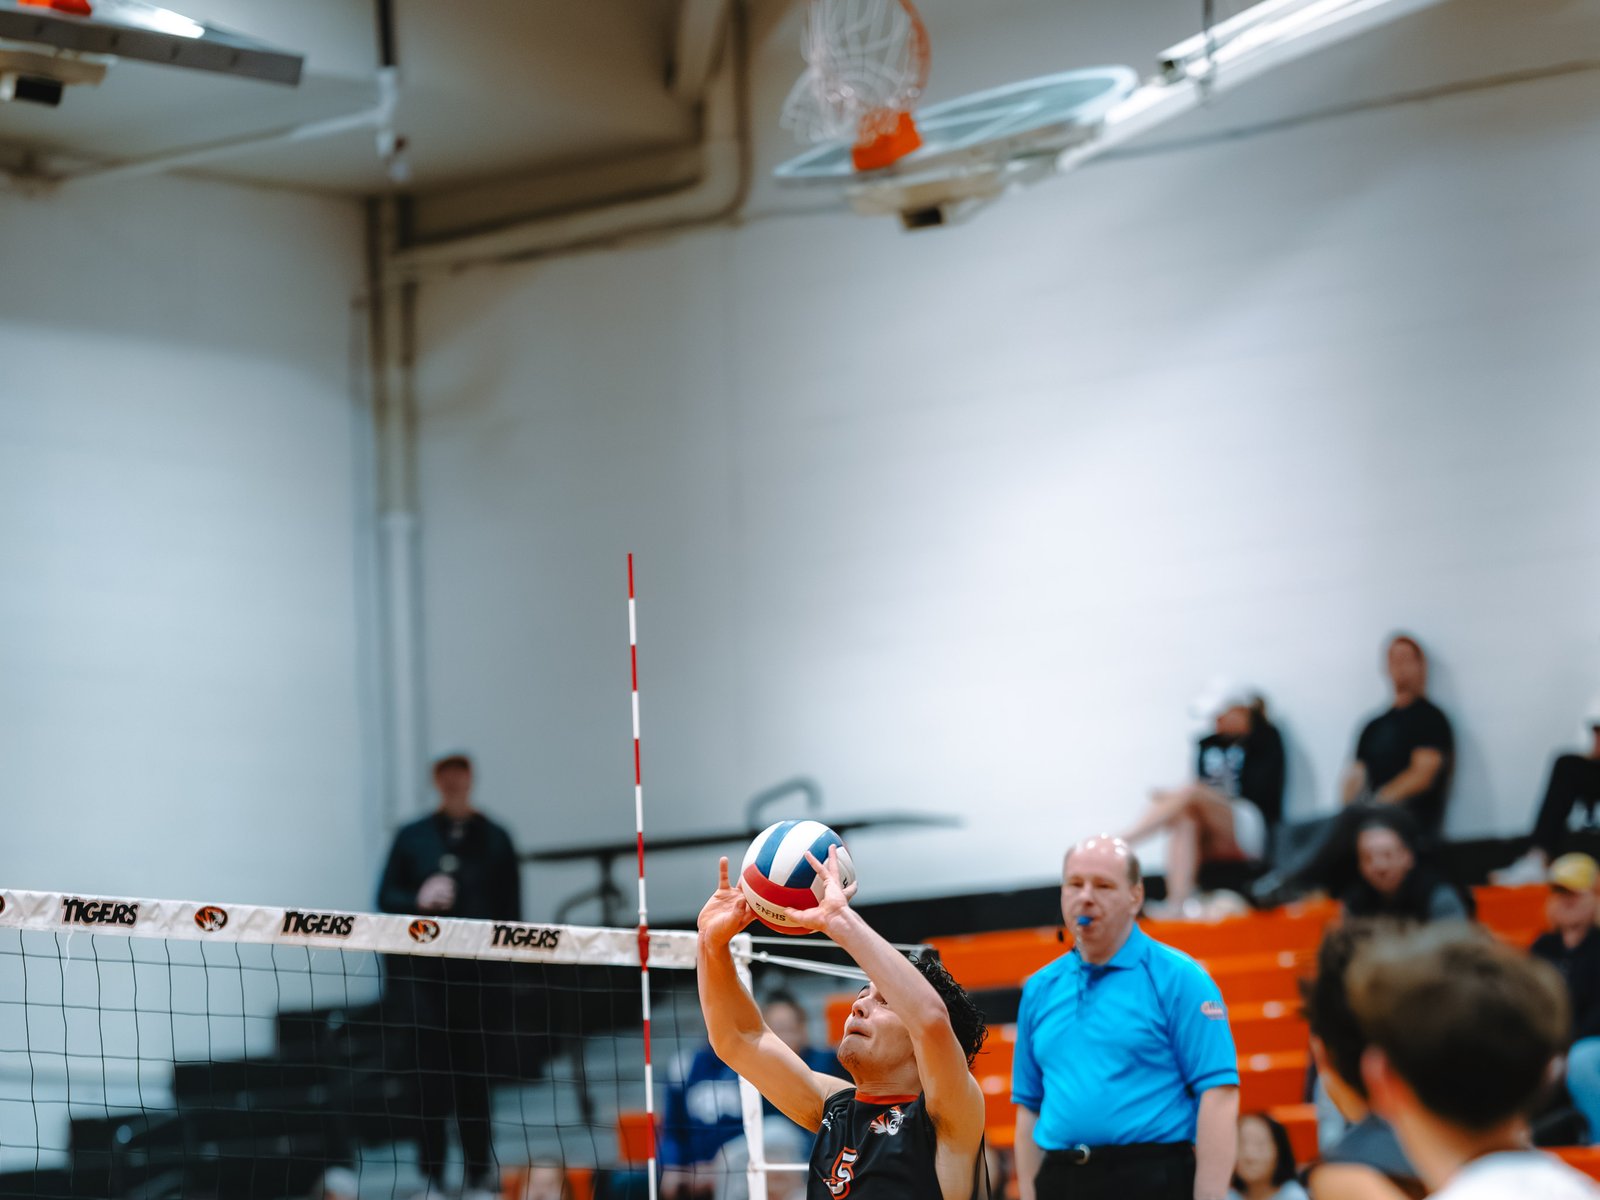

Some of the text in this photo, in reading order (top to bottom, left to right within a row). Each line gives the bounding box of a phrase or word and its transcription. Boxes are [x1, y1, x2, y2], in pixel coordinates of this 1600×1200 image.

[62, 897, 139, 926] TIGERS
[282, 910, 355, 937] TIGERS
[761, 906, 787, 922] NFHS
[491, 924, 561, 950] TIGERS
